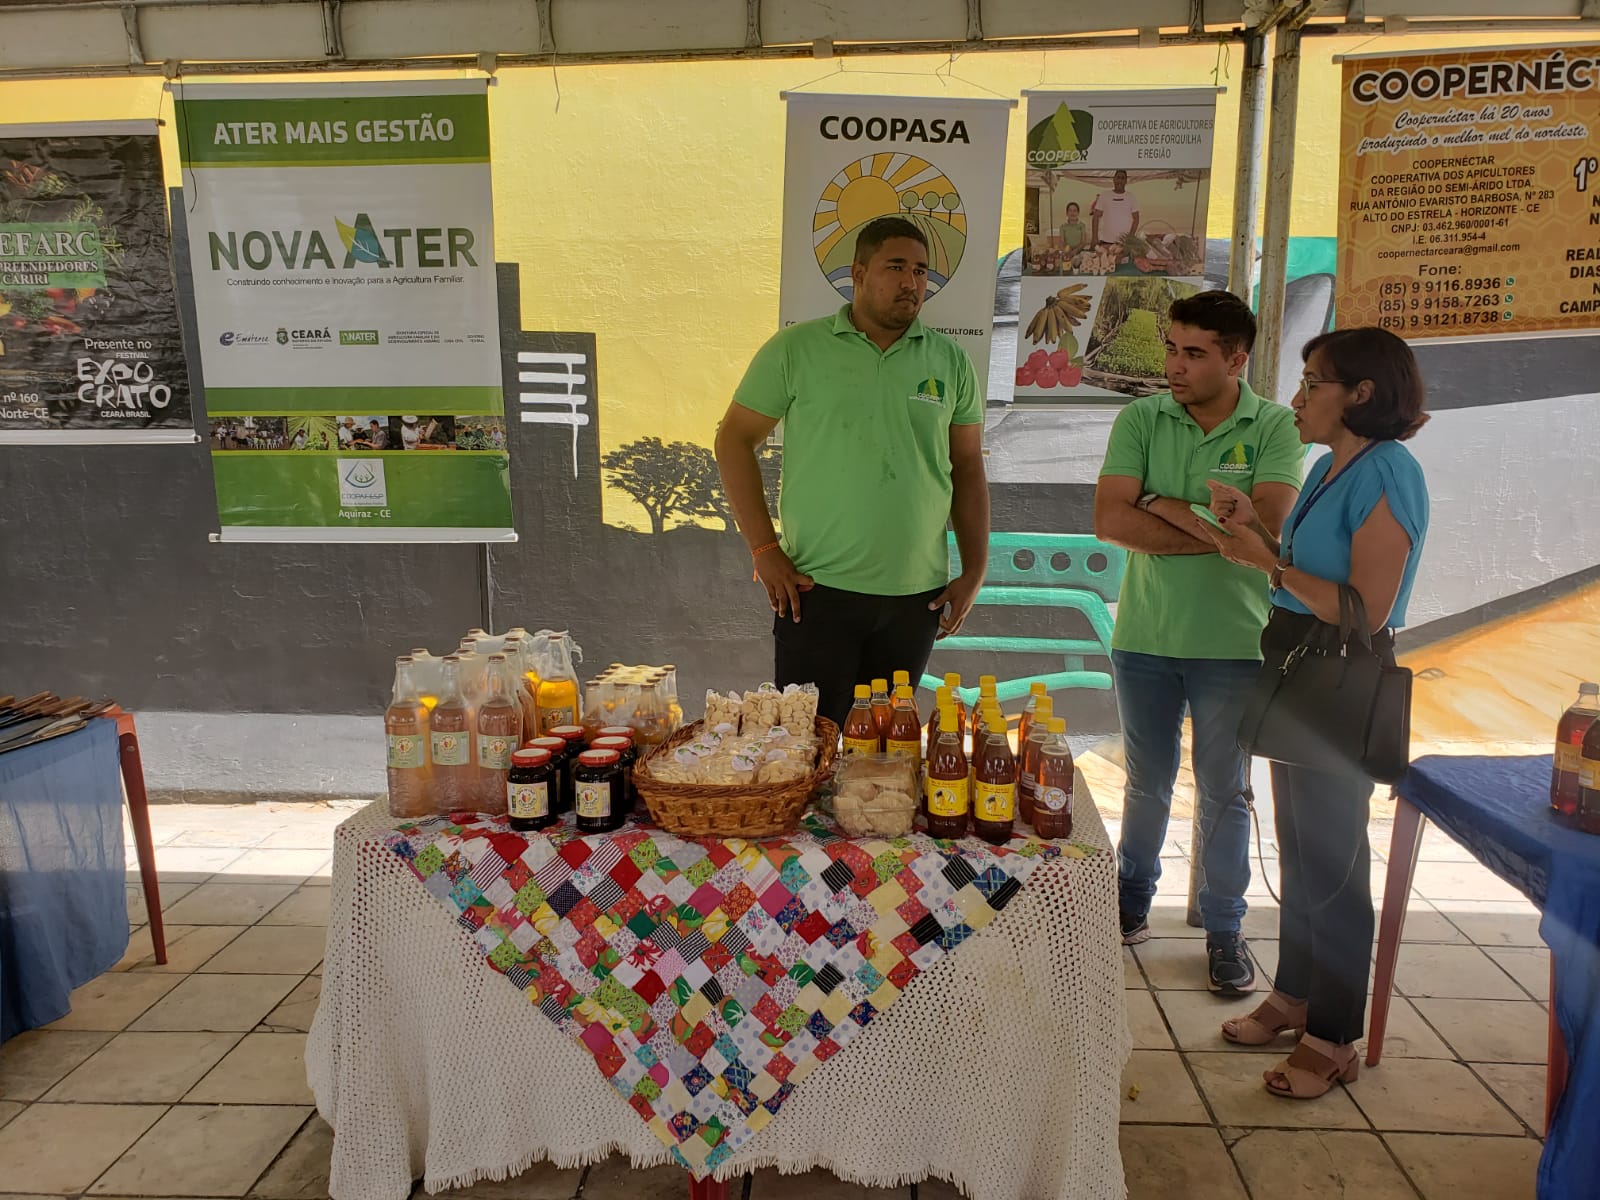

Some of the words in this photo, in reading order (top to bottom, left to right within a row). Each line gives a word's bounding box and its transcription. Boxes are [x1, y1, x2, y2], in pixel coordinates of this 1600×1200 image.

[1097, 119, 1147, 131] COOPERATIVA
[1148, 120, 1158, 130] DE
[1159, 119, 1214, 130] AGRICULTORES
[1395, 110, 1475, 129] Coopernéctar
[1480, 106, 1496, 121] há
[1500, 105, 1519, 119] 20
[1522, 107, 1551, 118] anos
[213, 121, 278, 145] ATER
[285, 120, 349, 144] MAIS
[355, 113, 455, 143] GESTÃO
[820, 115, 970, 144] COOPASA
[1107, 134, 1149, 145] FAMILIARES
[1150, 134, 1160, 144] DE
[1161, 133, 1202, 144] FORQUILHA
[1360, 134, 1428, 153] produzindo
[1431, 137, 1439, 145] o
[1443, 129, 1484, 144] melhor
[1488, 128, 1512, 141] mel
[1515, 126, 1530, 140] do
[1534, 125, 1587, 139] nordeste.
[1027, 150, 1089, 163] COOPFOR
[1137, 149, 1143, 159] E
[1143, 147, 1171, 159] REGIÃO
[1412, 155, 1495, 170] COOPERNÉCTAR
[1371, 172, 1441, 185] COOPERATIVA
[1443, 170, 1464, 180] DOS
[1466, 166, 1536, 179] APICULTORES
[1573, 157, 1599, 192] 1º
[1371, 188, 1385, 198] DA
[1387, 184, 1425, 197] REGIÃO
[1428, 184, 1443, 194] DO
[1445, 179, 1504, 193] SEMI-ÁRIDO
[1506, 179, 1535, 189] LTDA.
[1350, 201, 1371, 211] RUA
[1372, 198, 1417, 210] ANTÔNIO
[1419, 195, 1468, 207] EVARISTO
[1470, 192, 1522, 203] BARBOSA,
[1538, 190, 1555, 200] 283
[1362, 213, 1388, 223] ALTO
[1390, 212, 1405, 221] DO
[1407, 209, 1452, 220] ESTRELA
[1460, 205, 1518, 217] HORIZONTE
[1526, 204, 1540, 213] CE
[1391, 223, 1421, 234] CNPJ:
[1422, 219, 1509, 232] 03.462.960/0001-61
[0, 231, 97, 257] EFARC
[208, 230, 336, 271] NOVA
[343, 213, 479, 270] ATER
[1412, 236, 1427, 245] I.E.
[1429, 232, 1487, 244] 06.311.954-4
[1377, 243, 1521, 259] coopernectarceara@gmail.com
[3, 272, 49, 285] CARIRI
[1418, 264, 1463, 276] Fone:
[226, 278, 271, 286] Construindo
[272, 276, 323, 286] conhecimento
[367, 276, 384, 286] para
[393, 275, 432, 286] Agricultura
[433, 274, 465, 283] Familiar.
[1379, 281, 1407, 298] (85)
[1411, 281, 1421, 293] 9
[1425, 277, 1501, 293] 9116.8936
[1378, 299, 1406, 315] (85)
[1410, 298, 1419, 310] 9
[1424, 294, 1500, 309] 9158.7263
[1377, 316, 1406, 329] (85)
[1410, 315, 1419, 327] 9
[1423, 310, 1499, 326] 9121.8738
[291, 327, 332, 339] CEARÁ
[84, 338, 136, 350] Presente
[137, 339, 152, 350] no
[77, 357, 154, 386] EXPO
[3, 391, 17, 403] nº
[20, 393, 39, 403] 160
[77, 382, 172, 409] CRATO
[100, 410, 125, 418] CEARÁ
[126, 410, 152, 418] BRASIL
[338, 509, 373, 519] Aquiraz
[380, 509, 392, 518] CE
